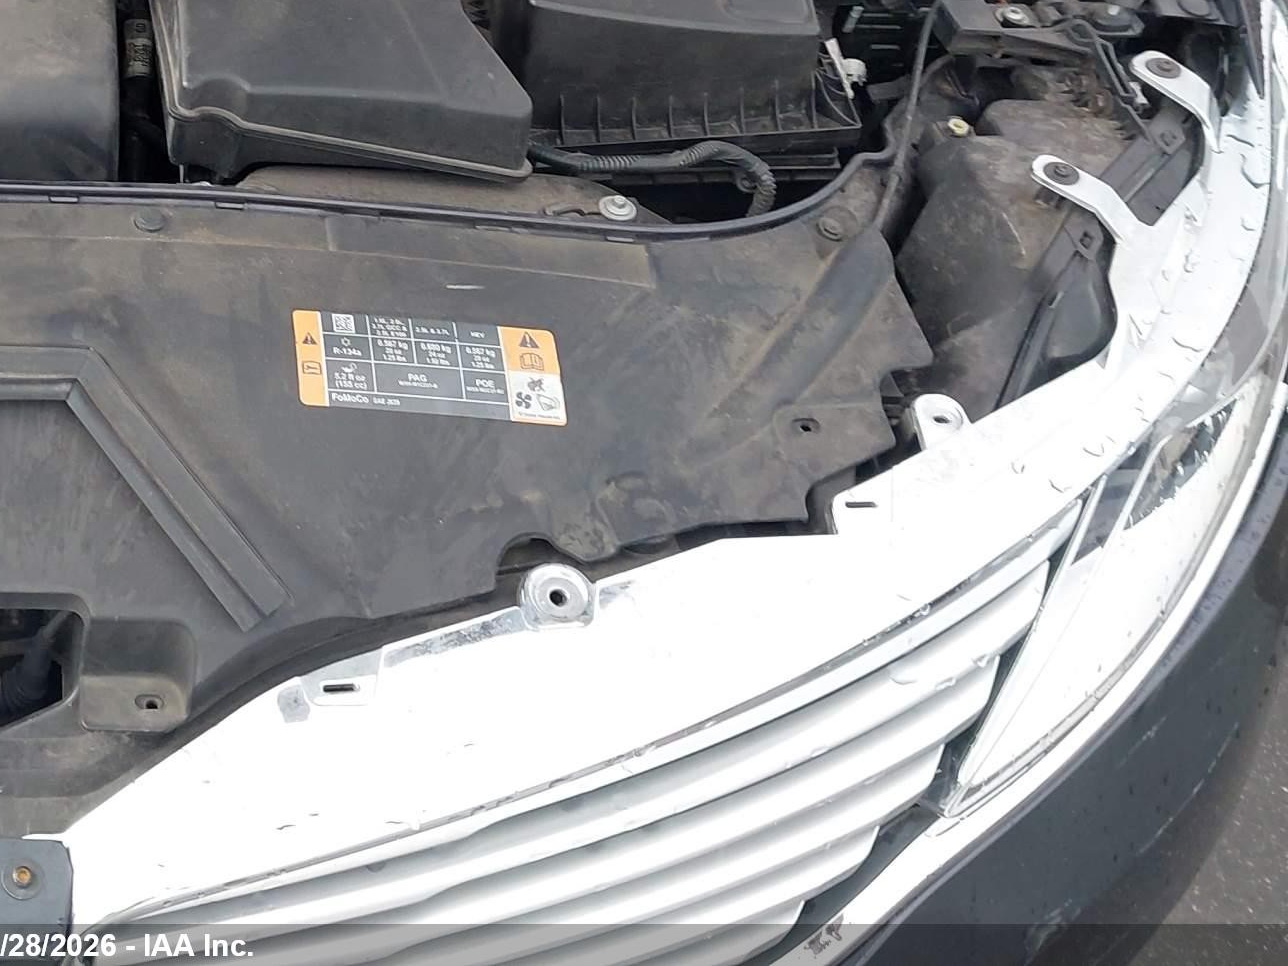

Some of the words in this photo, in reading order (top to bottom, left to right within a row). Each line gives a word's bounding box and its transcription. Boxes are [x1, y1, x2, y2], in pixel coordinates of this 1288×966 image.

[397, 340, 409, 350] kg
[441, 344, 452, 354] kg
[332, 346, 362, 357] R-134a
[485, 348, 496, 359] kg
[334, 371, 347, 380] 5.2
[407, 372, 428, 382] PAG
[475, 378, 495, 389] POE
[331, 392, 369, 404] FoMoCo
